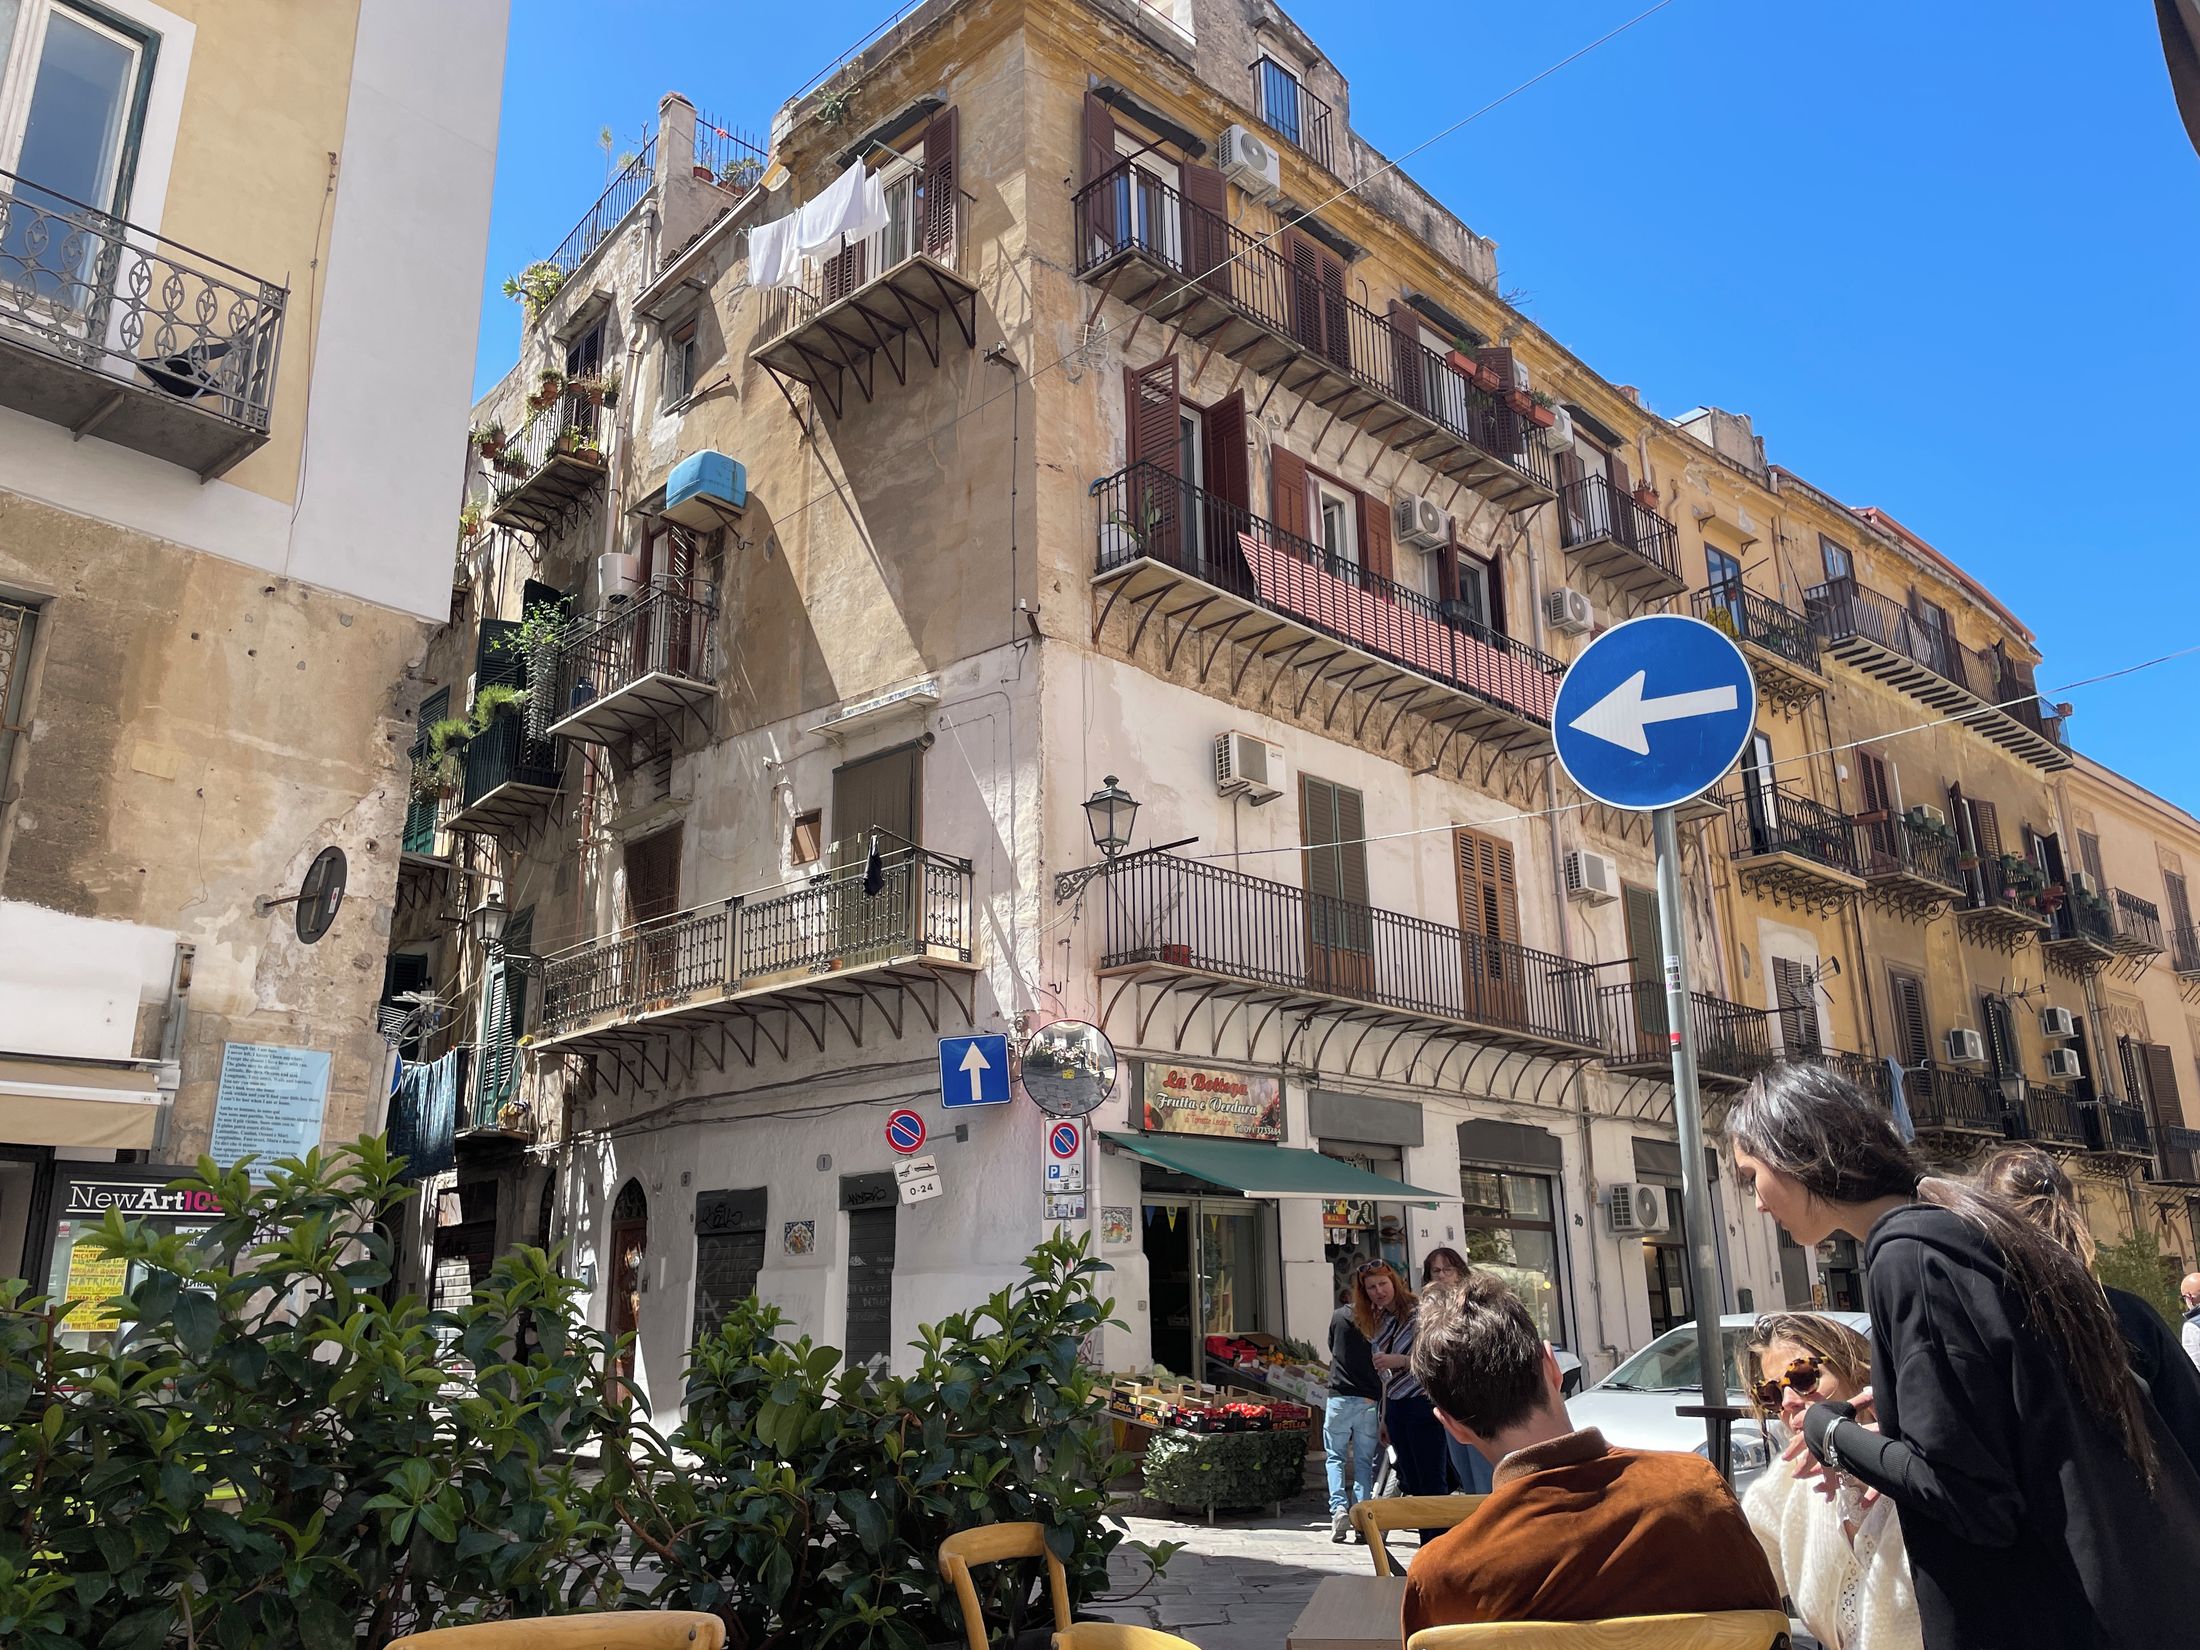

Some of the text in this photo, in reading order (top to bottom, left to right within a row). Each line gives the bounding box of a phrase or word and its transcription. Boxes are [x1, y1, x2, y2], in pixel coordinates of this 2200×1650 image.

[1163, 1070, 1249, 1098] La Bottega
[1154, 1092, 1258, 1116] Frutta e Verdura
[909, 1183, 934, 1196] 0-24
